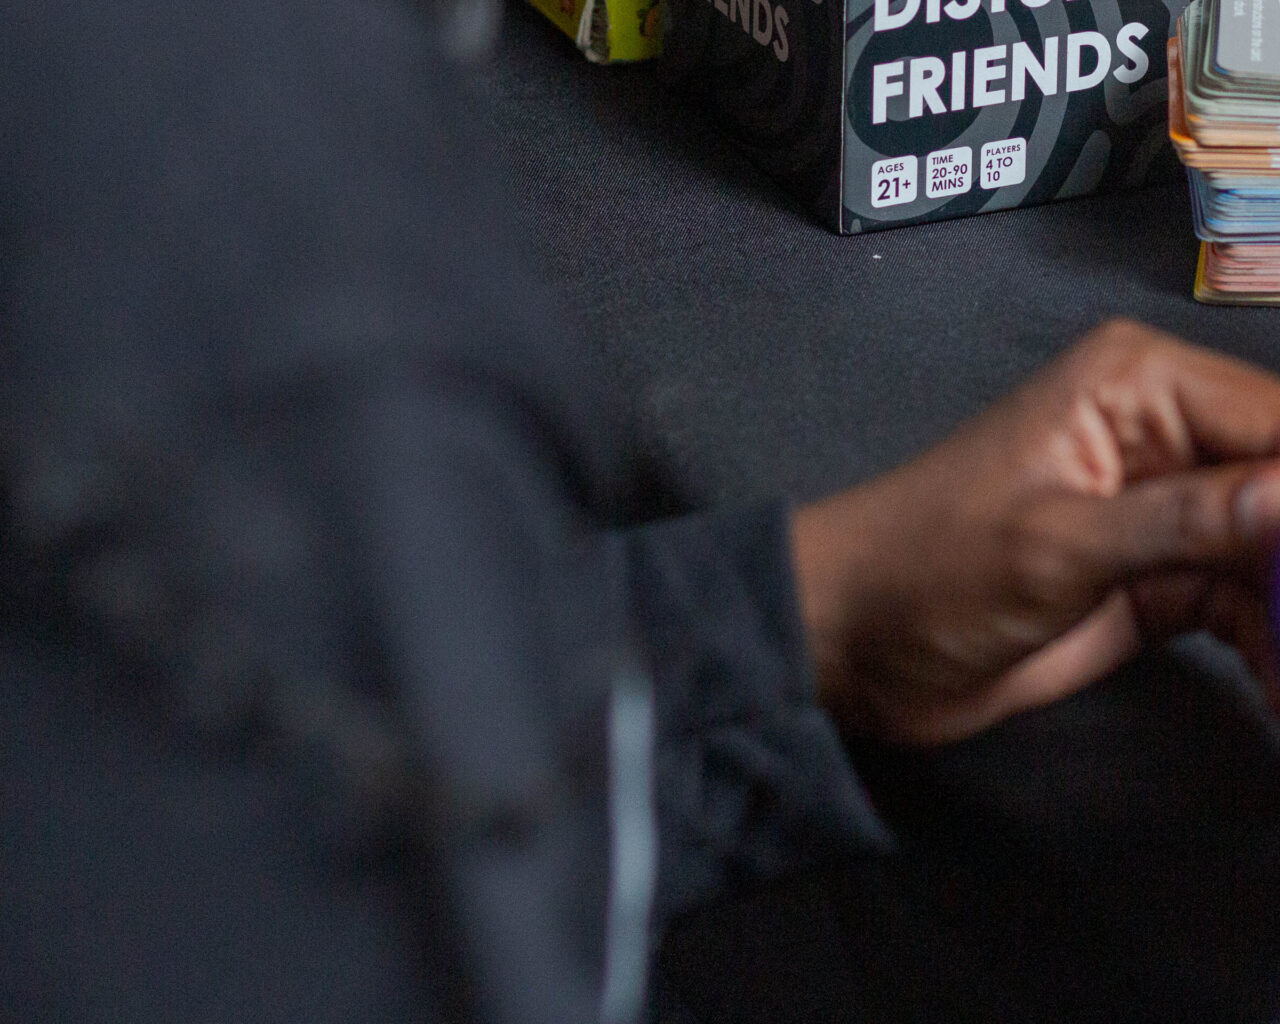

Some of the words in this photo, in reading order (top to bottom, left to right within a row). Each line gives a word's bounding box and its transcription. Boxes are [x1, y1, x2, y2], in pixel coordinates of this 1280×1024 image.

[872, 22, 1150, 125] FRIENDS
[986, 144, 1021, 156] PLAYERS
[932, 154, 954, 165] TIME
[985, 159, 993, 170] 4
[997, 156, 1013, 169] TO
[877, 162, 905, 175] AGES
[931, 163, 968, 180] 20-90
[986, 170, 1001, 183] 10
[877, 176, 911, 201] 21+
[931, 176, 964, 192] MINS
